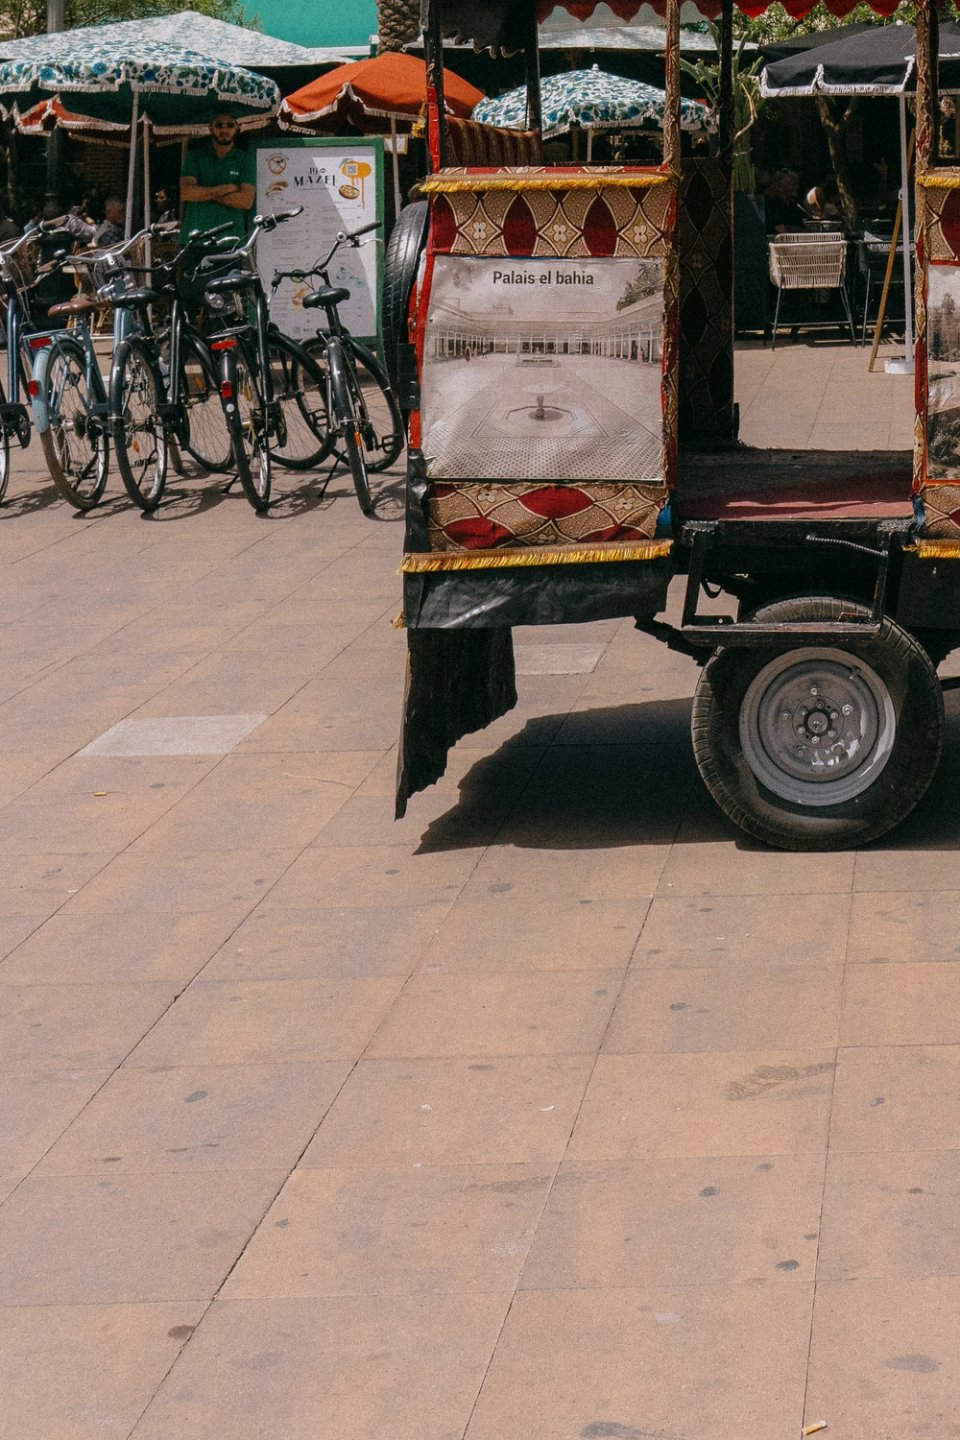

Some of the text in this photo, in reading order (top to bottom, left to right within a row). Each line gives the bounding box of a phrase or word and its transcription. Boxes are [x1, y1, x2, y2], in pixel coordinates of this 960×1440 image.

[493, 270, 594, 285] Palais el bahia
